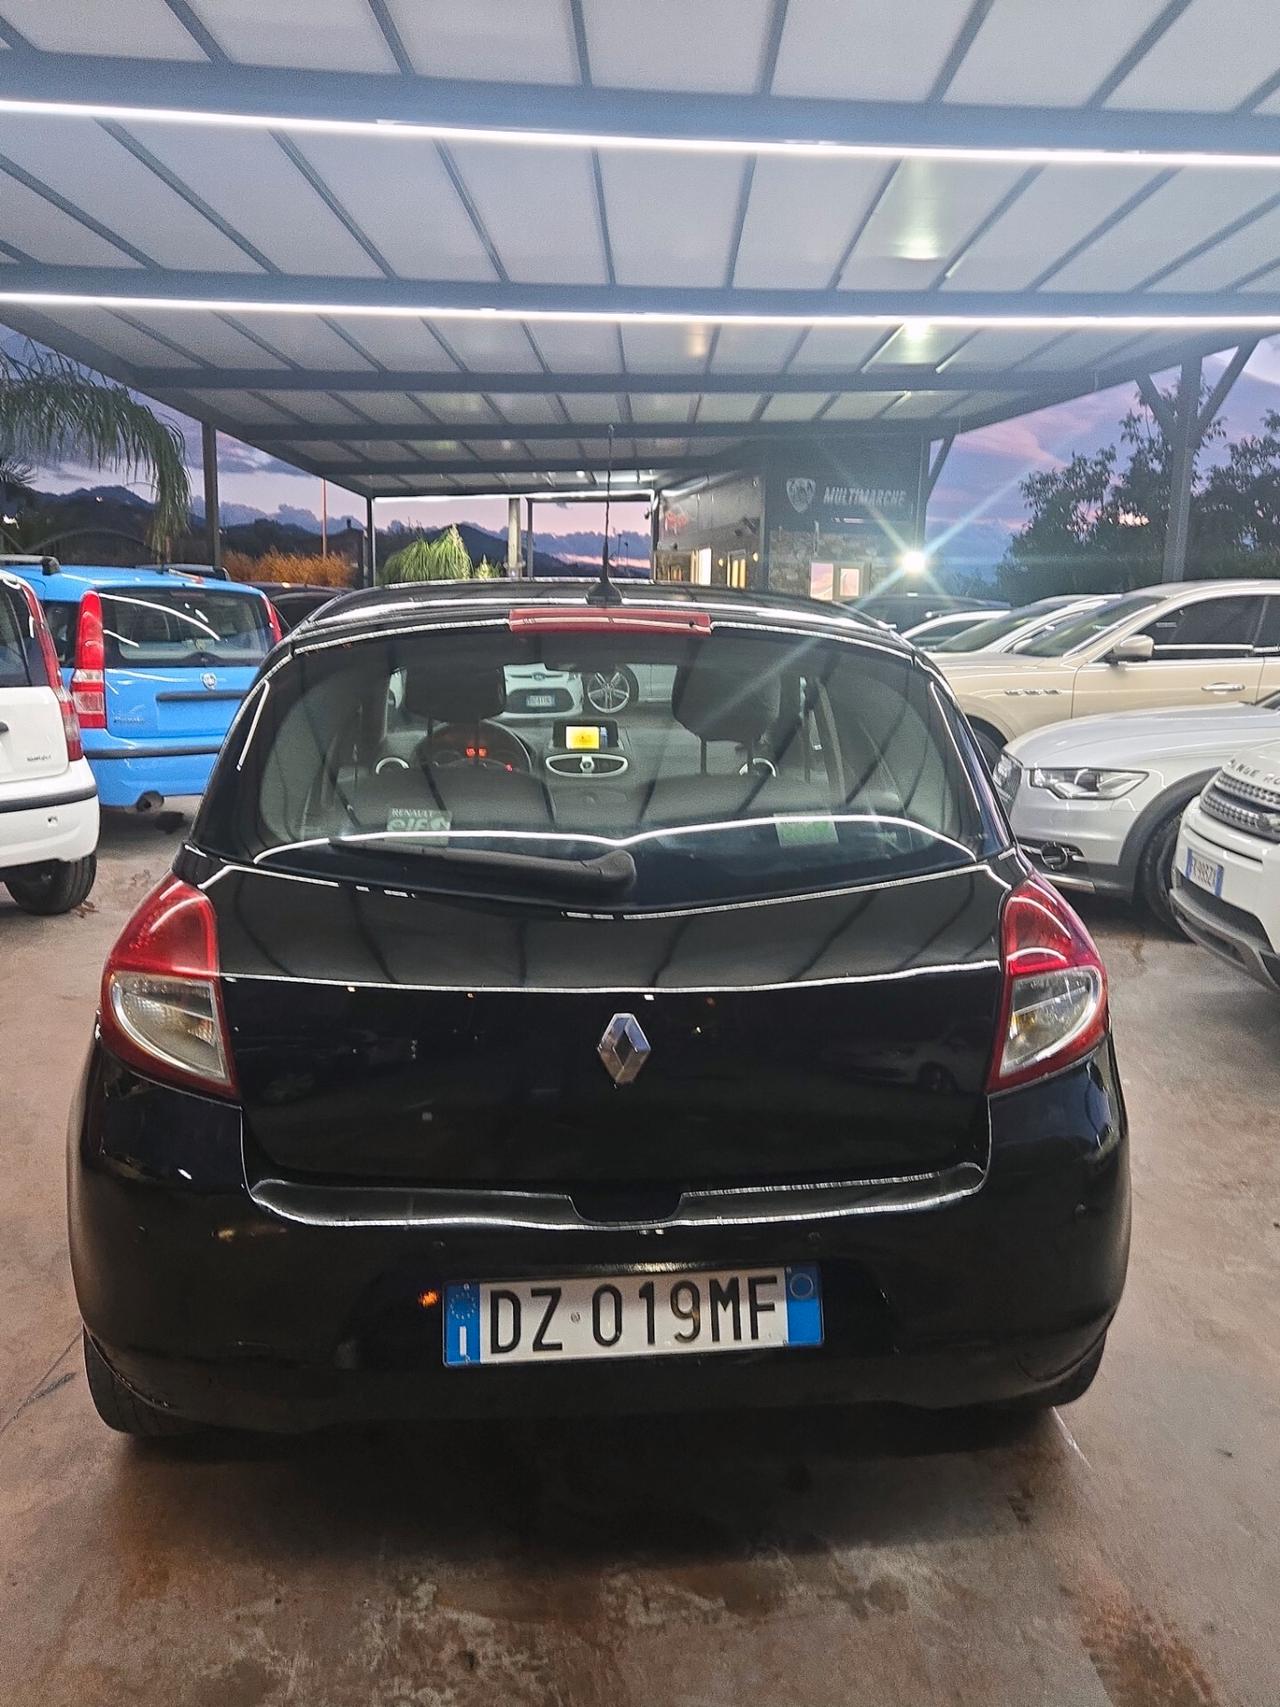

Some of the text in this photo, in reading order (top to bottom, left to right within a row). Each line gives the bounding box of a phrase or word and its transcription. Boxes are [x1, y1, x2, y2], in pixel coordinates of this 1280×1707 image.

[391, 808, 434, 818] RENAULT
[489, 1276, 779, 1355] DZ 019MF
